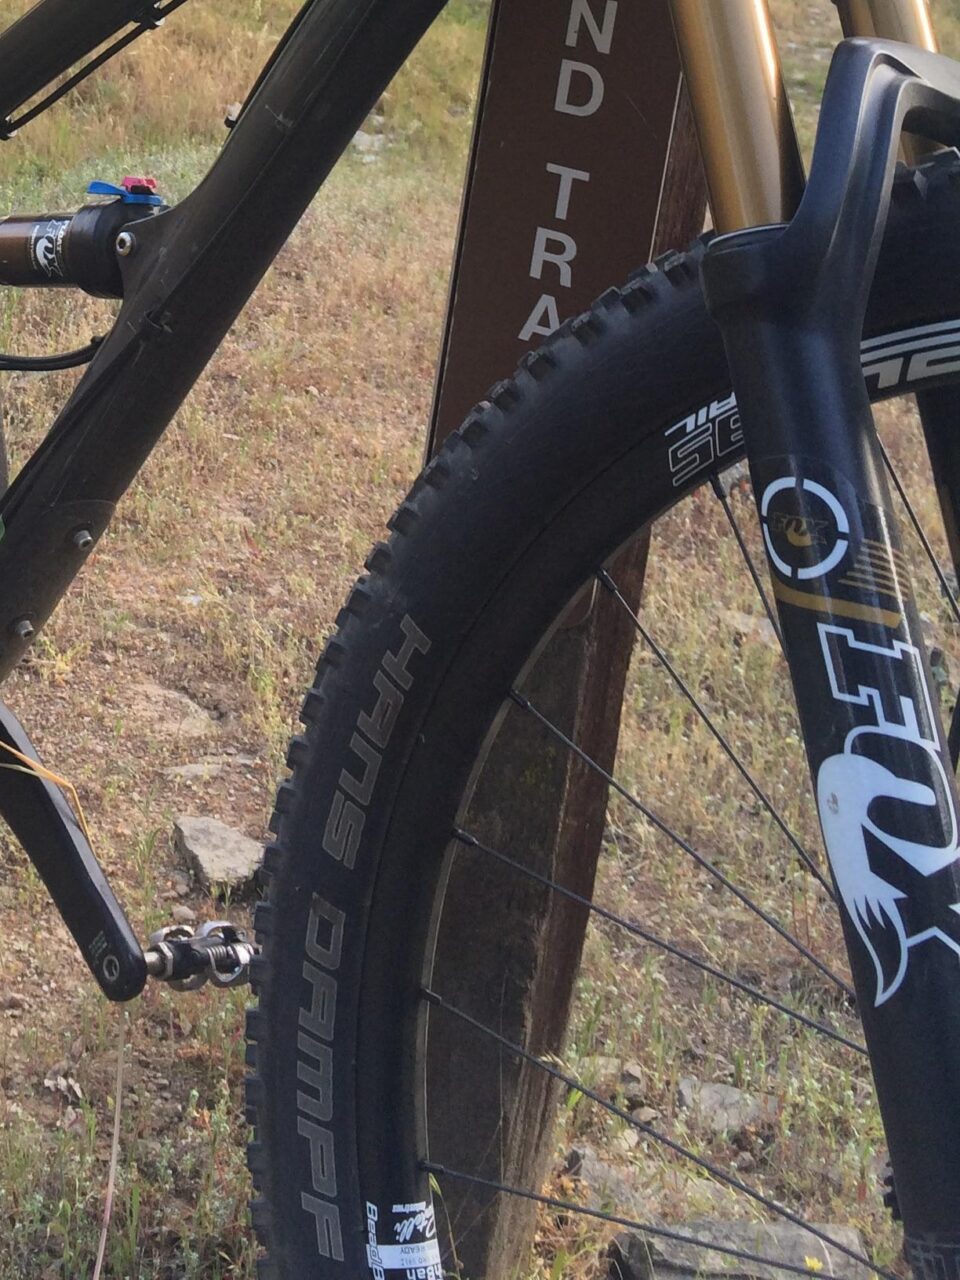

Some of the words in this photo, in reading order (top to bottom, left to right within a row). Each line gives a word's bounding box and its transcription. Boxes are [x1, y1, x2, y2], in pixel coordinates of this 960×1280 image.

[322, 615, 432, 869] HANS
[816, 621, 960, 1008] FOX
[296, 892, 346, 1263] DAMPF
